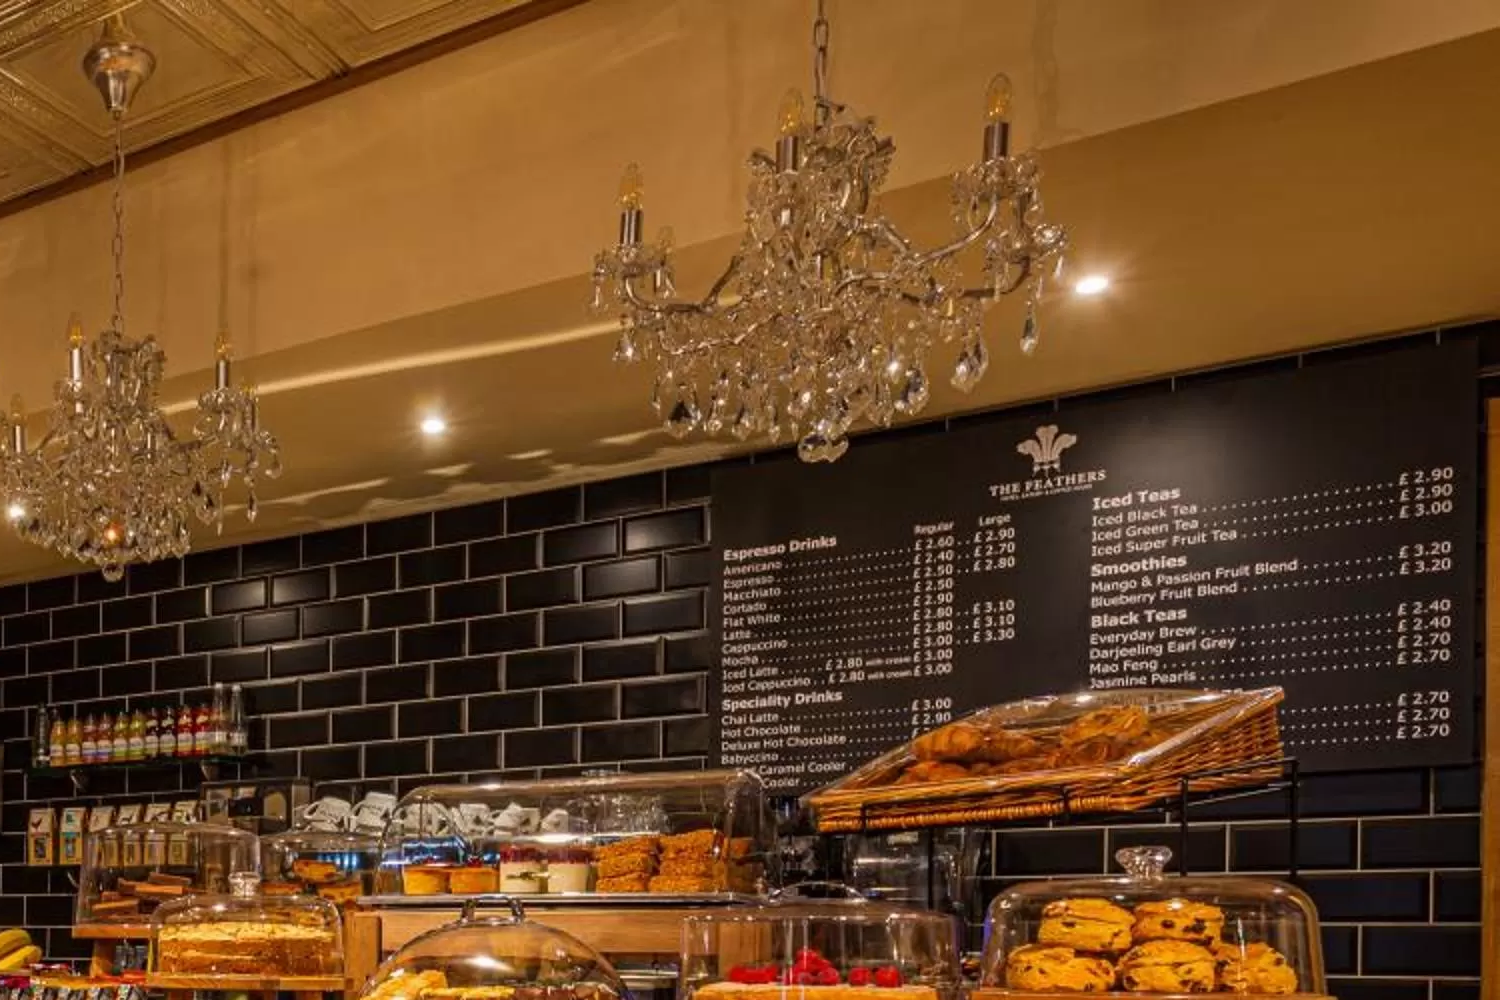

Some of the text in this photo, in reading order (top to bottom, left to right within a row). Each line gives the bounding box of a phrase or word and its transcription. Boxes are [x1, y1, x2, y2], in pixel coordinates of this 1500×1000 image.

[989, 482, 1020, 497] THE
[1025, 469, 1107, 491] FEATHERS
[1092, 512, 1123, 527] Iced
[1127, 507, 1167, 523] Black
[1171, 504, 1197, 517] Tea
[1414, 467, 1453, 483] 2.90
[1092, 492, 1133, 511] Iced
[1136, 488, 1181, 503] Teas
[979, 514, 1011, 526] Large
[1092, 527, 1122, 542] Iced
[1126, 522, 1169, 537] Green
[1174, 519, 1199, 531] Tea
[1414, 483, 1453, 500] 2.90
[1092, 542, 1122, 557] Iced
[1125, 536, 1168, 553] Super
[1172, 532, 1207, 547] Fruit
[1211, 529, 1237, 541] Tea
[1414, 500, 1453, 517] 3.00
[723, 535, 837, 562] Espresso Drinks
[723, 575, 774, 589] Espresso
[985, 541, 1015, 556] 2.70
[723, 560, 782, 576] Americano
[1091, 555, 1187, 577] Smoothies
[1091, 578, 1137, 594] Mango
[1141, 575, 1152, 587] &
[1157, 570, 1210, 585] Passion
[1215, 564, 1250, 579] Fruit
[1255, 558, 1298, 575] Blend
[1414, 541, 1451, 557] 3.20
[723, 587, 780, 601] Macchiato
[1091, 592, 1156, 609] Blueberry
[1160, 587, 1193, 601] Fruit
[1197, 582, 1237, 596] Blend
[1414, 557, 1451, 573] 3.20
[723, 602, 767, 615] Cortado
[1091, 608, 1187, 629] Black Teas
[723, 629, 751, 641] Latte
[984, 599, 1015, 613] 3.10
[723, 617, 744, 628] Flat
[747, 613, 780, 625] White
[1090, 628, 1155, 645] Everyday
[1159, 625, 1197, 639] Brew
[1412, 600, 1451, 615] 2.40
[722, 639, 788, 654] Cappuccino
[984, 613, 1015, 628] 3.10
[1089, 643, 1163, 660] Darjeeling
[1167, 639, 1196, 653] Earl
[1200, 636, 1236, 651] Grey
[1412, 615, 1451, 631] 2.40
[722, 655, 758, 667] Mocha
[1089, 661, 1119, 675] Mao
[1123, 659, 1158, 672] Feng
[1412, 632, 1451, 647] 2.70
[723, 668, 746, 680] Iced
[749, 667, 779, 678] Latte
[1090, 674, 1147, 690] Jasmine
[1151, 670, 1197, 685] Pearls
[1412, 648, 1450, 663] 2.70
[723, 682, 745, 693] Iced
[748, 676, 811, 691] Cappuccino
[722, 690, 843, 713] Speciality Drinks
[1412, 691, 1449, 705] 2.70
[721, 715, 747, 726] Chai
[749, 712, 779, 724] Latte
[923, 697, 952, 710] 3.00
[1412, 707, 1450, 721] 2.70
[721, 728, 741, 739] Hot
[743, 724, 801, 738] Chocolate
[1412, 723, 1450, 738] 2.70
[721, 741, 760, 752] Deluxe
[763, 739, 783, 749] Hot
[786, 734, 846, 747] Chocolate
[721, 752, 779, 765] Babyccino
[759, 762, 805, 776] Caramel
[807, 761, 846, 773] Cooler
[761, 777, 800, 789] Cooler
